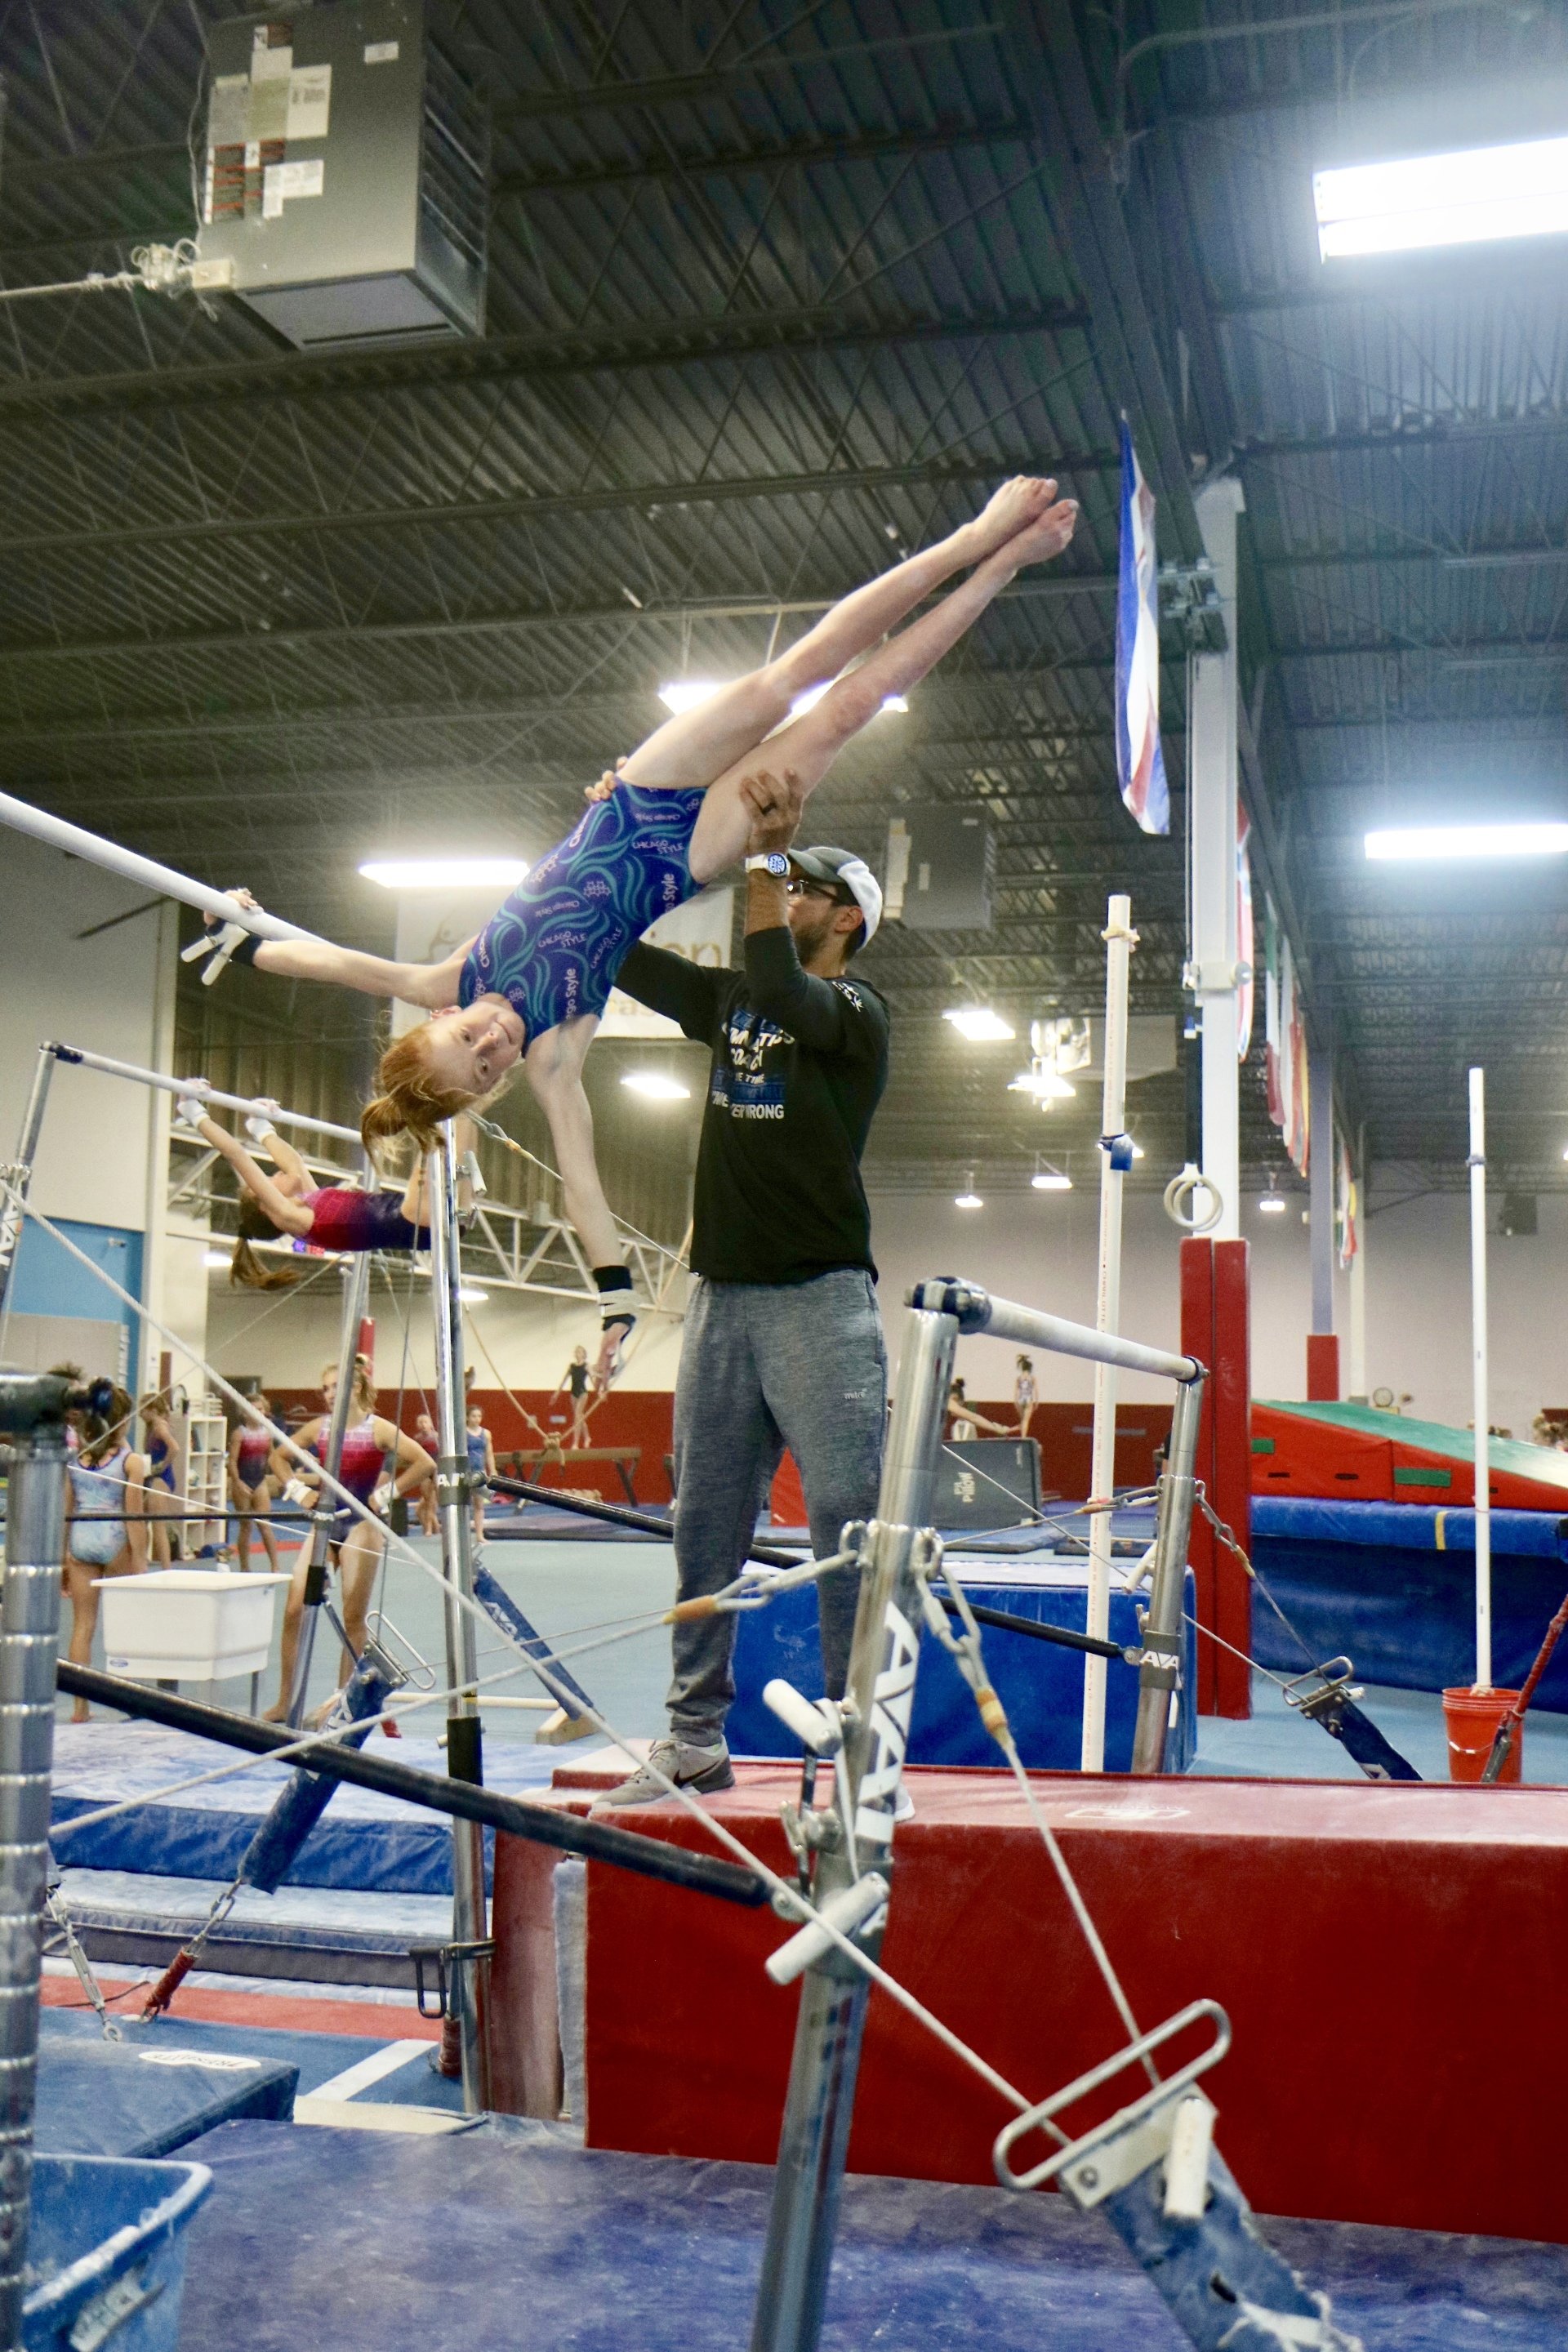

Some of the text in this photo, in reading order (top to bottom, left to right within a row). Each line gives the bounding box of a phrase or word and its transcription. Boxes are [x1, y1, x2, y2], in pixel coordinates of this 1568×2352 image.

[631, 840, 669, 849] CHICAGO
[656, 842, 685, 855] STYLE
[661, 873, 679, 902] Style
[537, 930, 572, 948] CHICAGO
[560, 933, 587, 948] STYLE
[564, 968, 579, 998] Style
